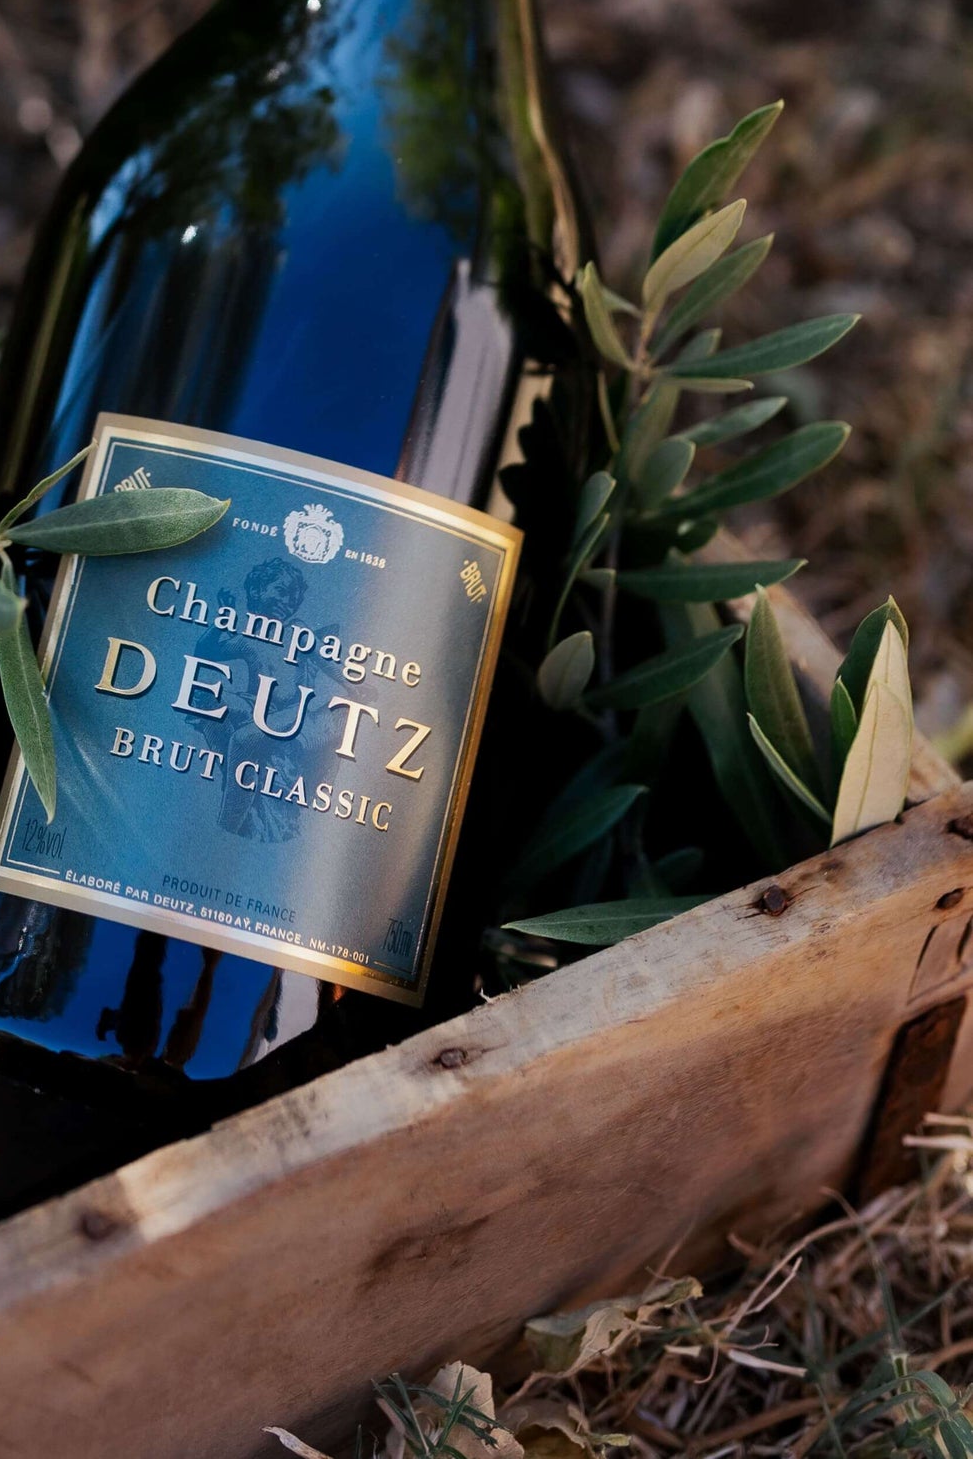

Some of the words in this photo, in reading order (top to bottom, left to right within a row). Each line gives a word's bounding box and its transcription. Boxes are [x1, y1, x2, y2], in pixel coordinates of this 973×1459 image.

[232, 517, 279, 537] FONDÉ
[345, 549, 358, 561] EN
[360, 552, 386, 569] 1838
[146, 576, 422, 687] Champagne
[94, 637, 432, 781] DEUTZ
[110, 727, 224, 780] BRUT
[235, 760, 393, 831] CLASSIC
[65, 869, 122, 894] ÉLABORÉ
[125, 886, 149, 901] PAR
[153, 893, 197, 916] DEUTZ,
[200, 906, 233, 925] 51160
[162, 875, 222, 901] PRODUIT
[226, 892, 243, 908] DE
[247, 898, 297, 924] FRANCE
